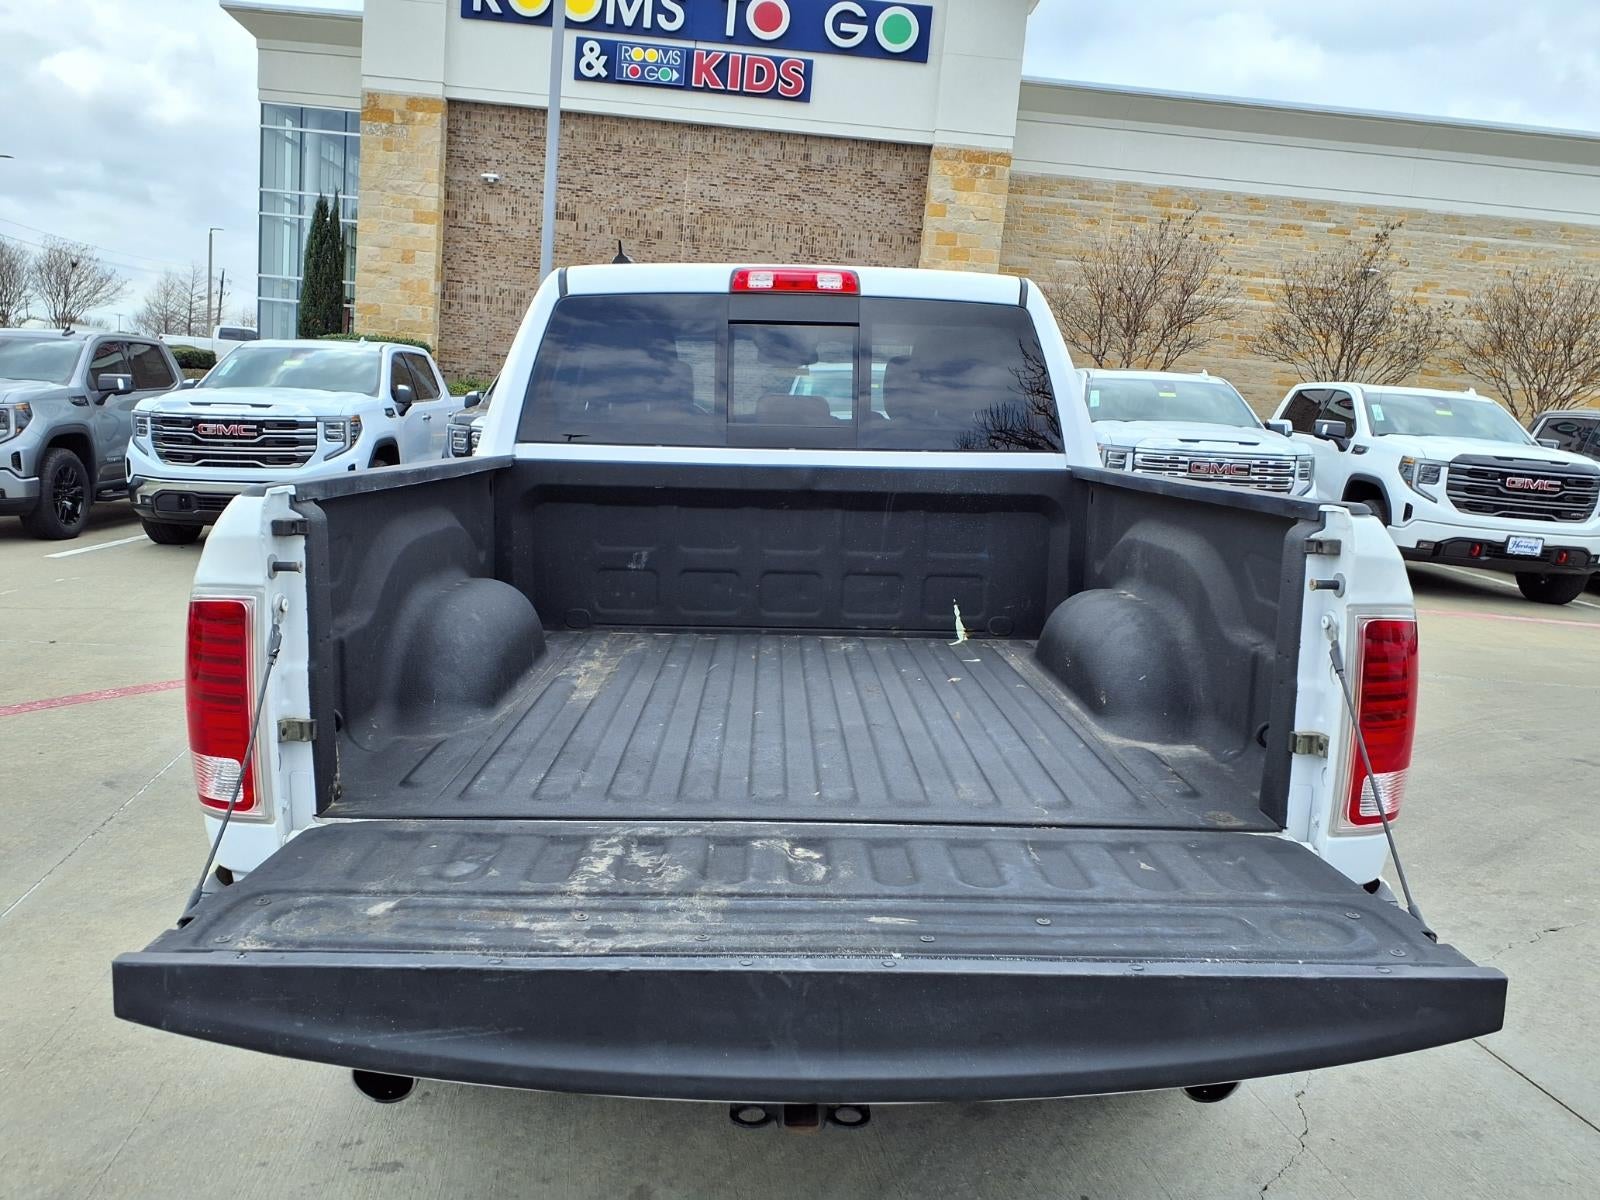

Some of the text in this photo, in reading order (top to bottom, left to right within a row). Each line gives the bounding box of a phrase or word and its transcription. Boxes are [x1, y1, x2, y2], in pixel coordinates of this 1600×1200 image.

[726, 0, 790, 40] TO
[824, 1, 920, 53] GO
[579, 40, 608, 78] &
[621, 46, 681, 65] ROOMS
[621, 63, 672, 81] TO GO
[692, 50, 804, 97] KIDS
[197, 423, 257, 436] GMC
[1191, 462, 1249, 476] GMC
[1506, 477, 1561, 491] GMC
